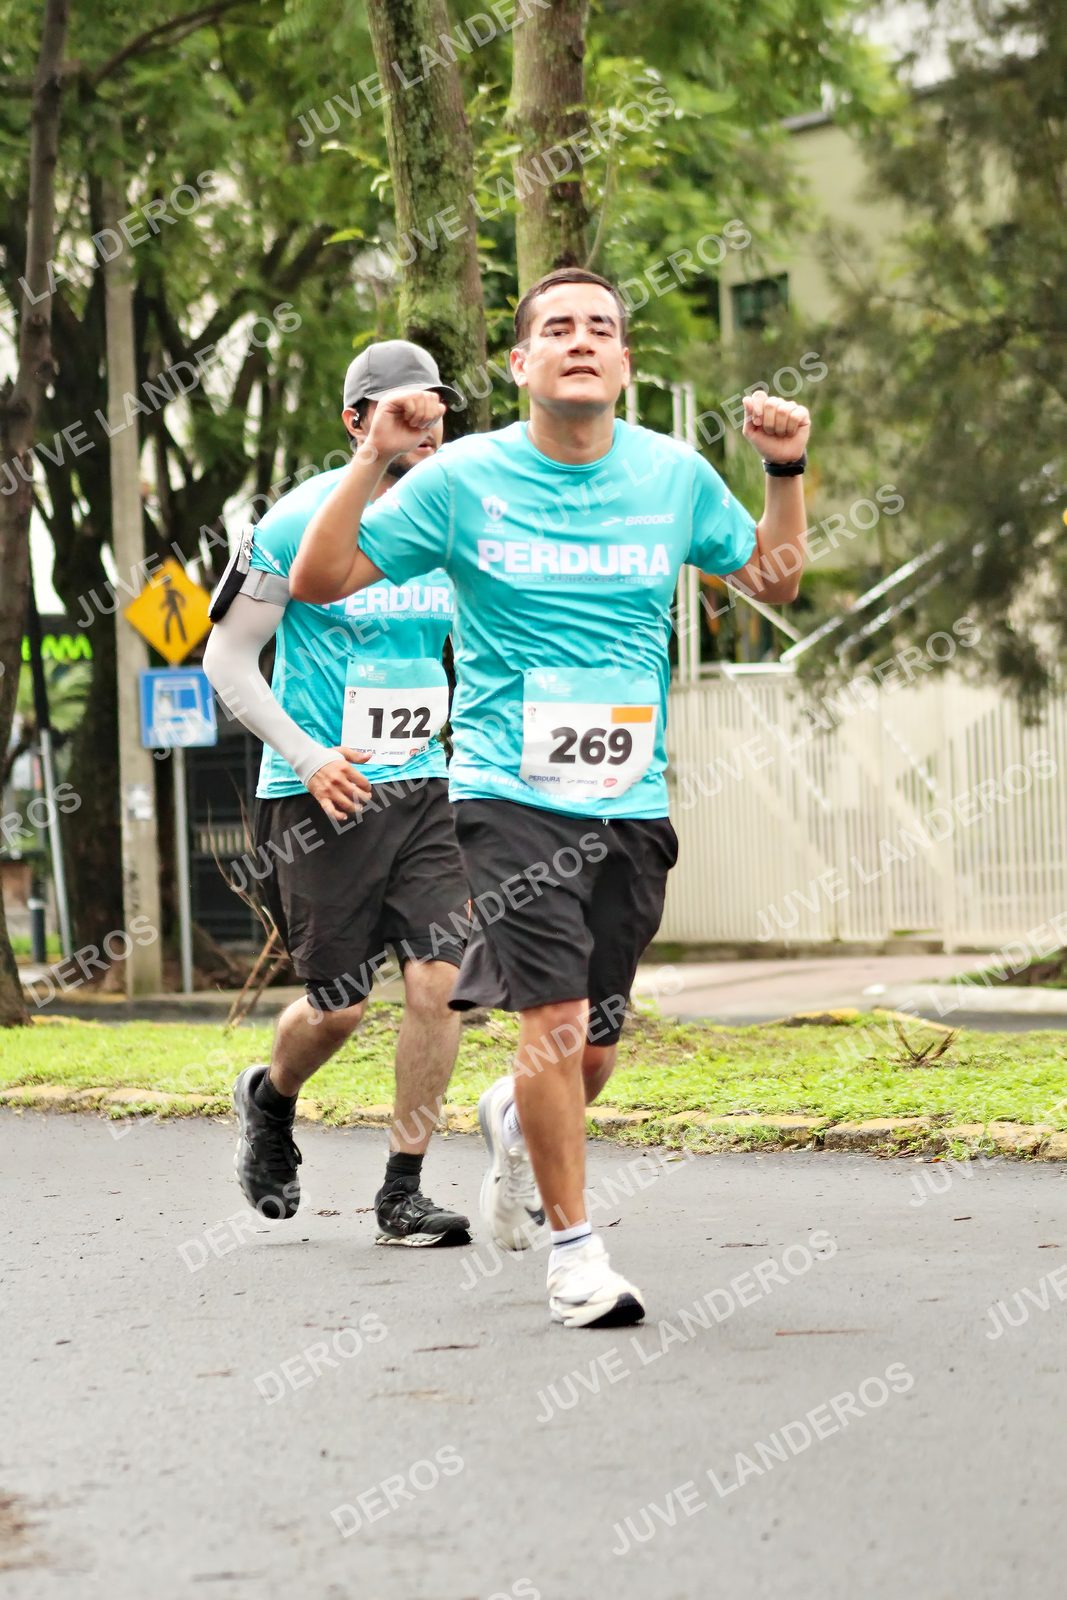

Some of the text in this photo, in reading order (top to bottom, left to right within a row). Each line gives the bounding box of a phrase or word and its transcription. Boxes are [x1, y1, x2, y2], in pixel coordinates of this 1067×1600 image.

[624, 514, 674, 526] BROOKS
[477, 539, 670, 576] PERDURA
[322, 586, 455, 616] ERDUR
[368, 706, 431, 738] 122
[548, 726, 632, 766] 269
